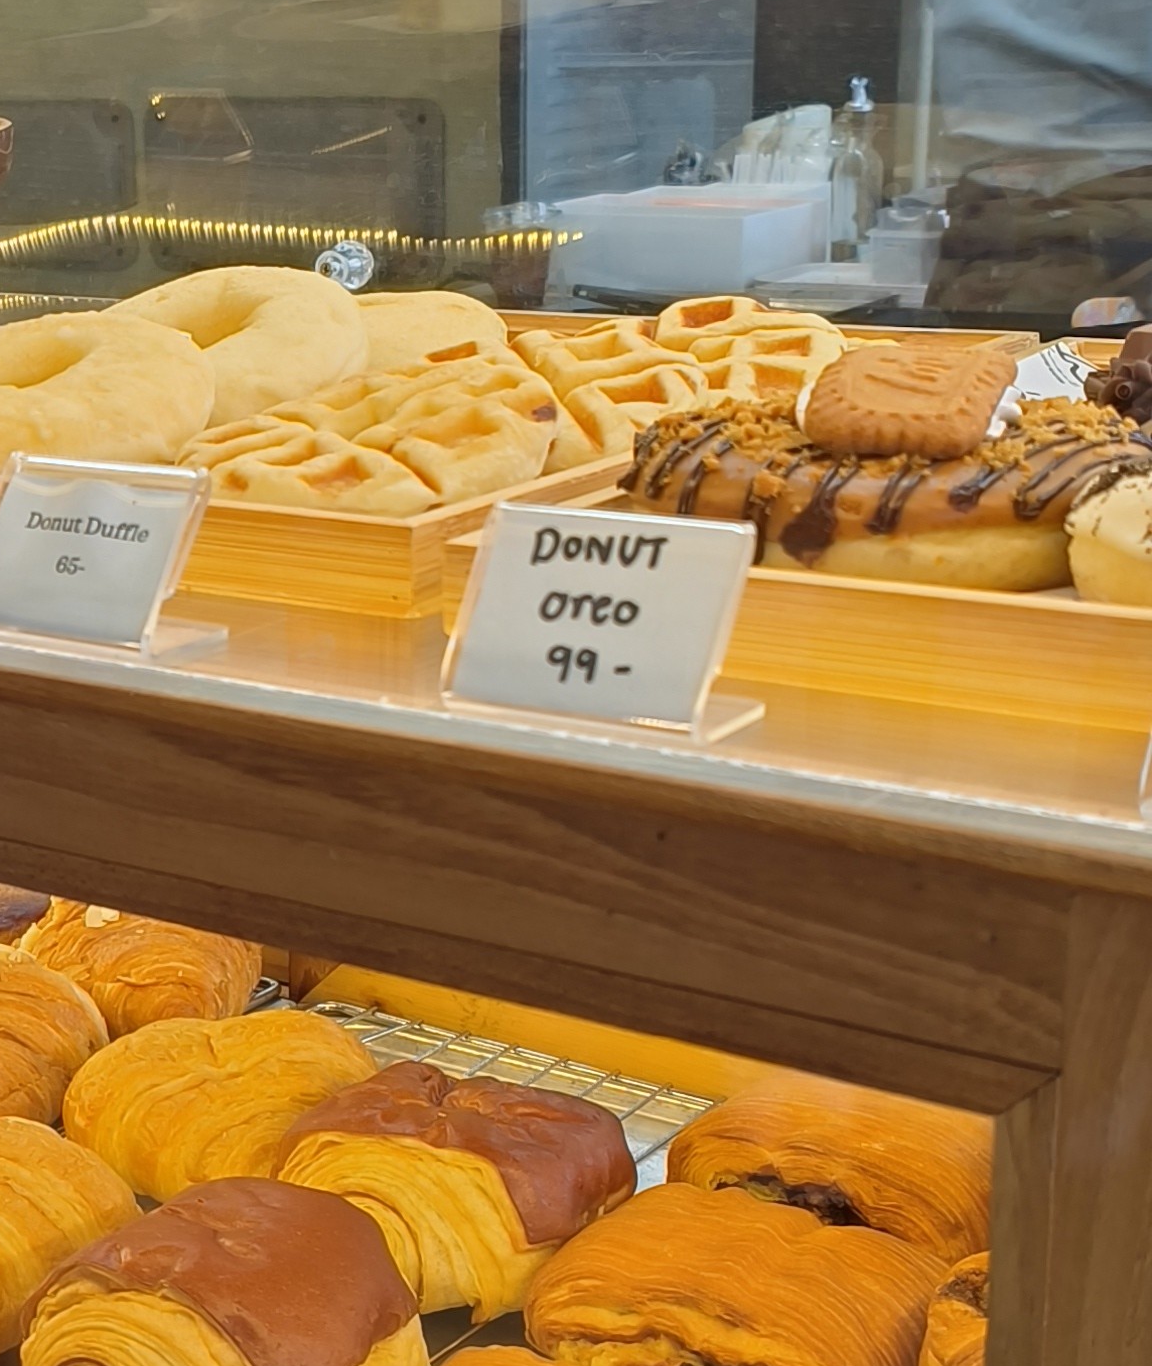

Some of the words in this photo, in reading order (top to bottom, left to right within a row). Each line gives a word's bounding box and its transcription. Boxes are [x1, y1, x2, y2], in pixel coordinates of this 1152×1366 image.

[25, 511, 82, 534] Donut
[84, 517, 150, 543] Duffle
[55, 555, 85, 575] 65-
